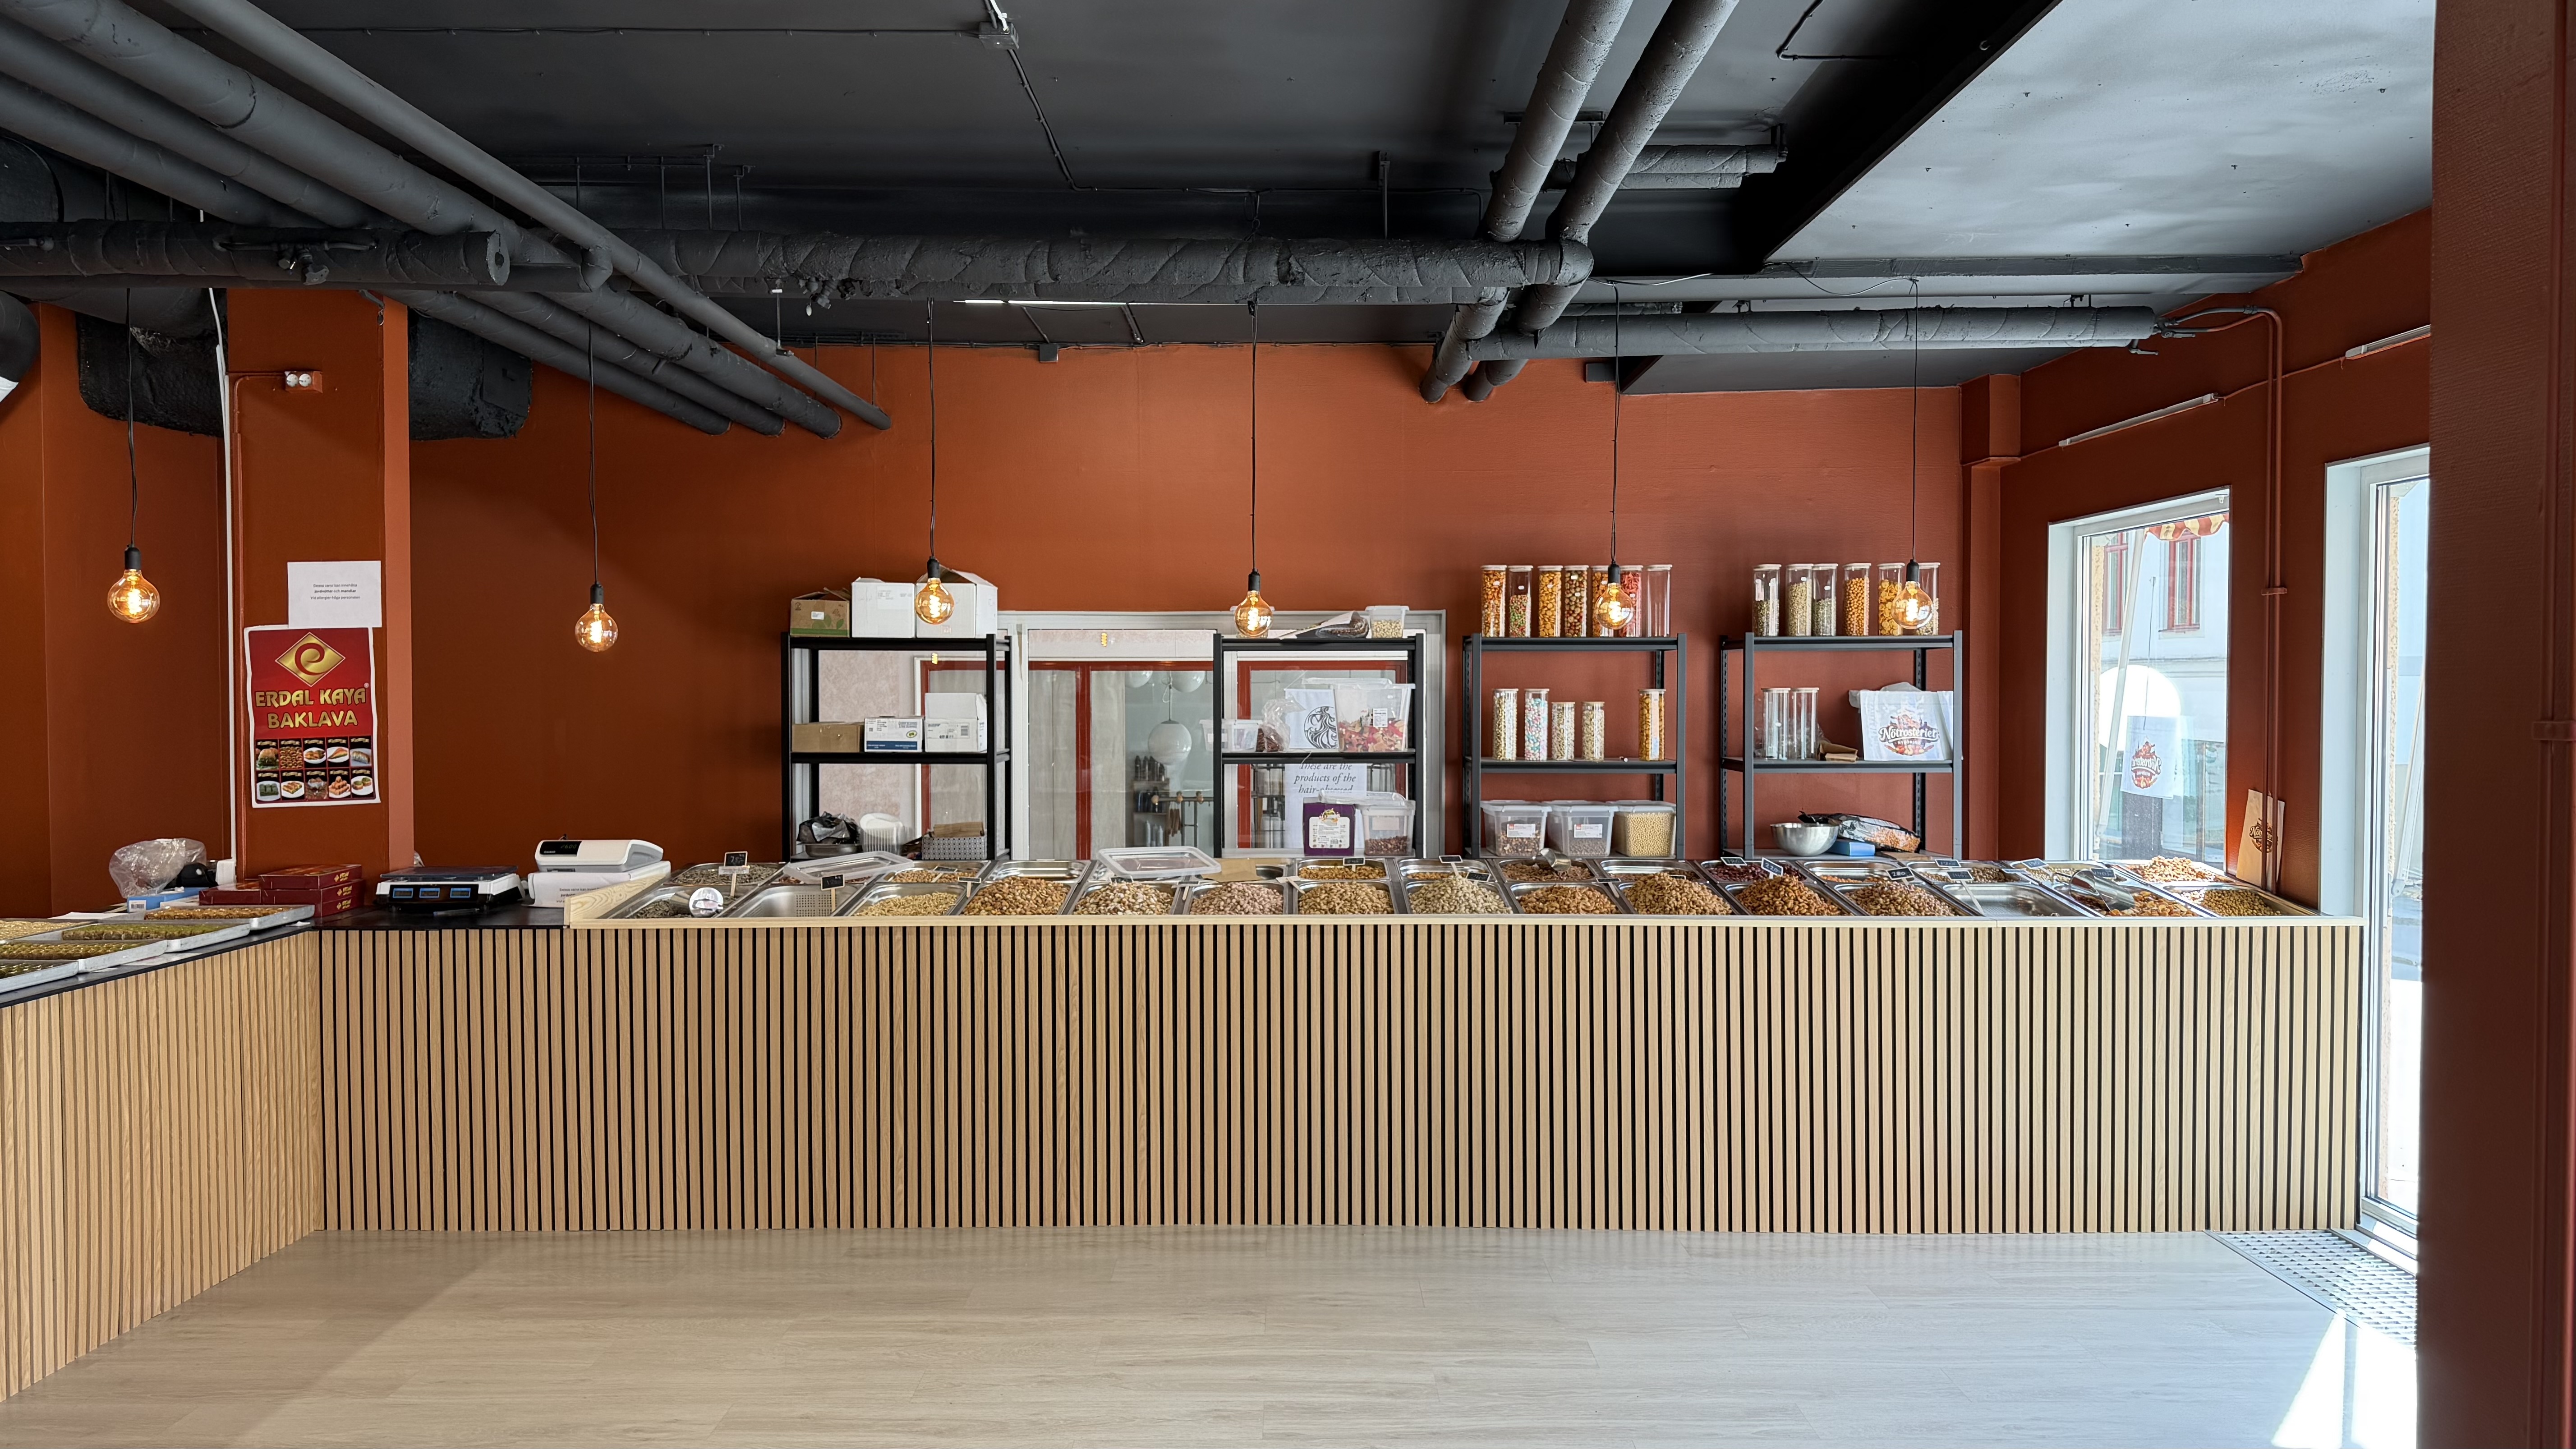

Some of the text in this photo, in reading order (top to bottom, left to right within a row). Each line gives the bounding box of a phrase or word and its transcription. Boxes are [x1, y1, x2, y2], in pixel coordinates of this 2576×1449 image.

[255, 688, 366, 708] ERDAL KAYA
[267, 710, 358, 729] BAKLAVA
[1294, 773, 1356, 785] products of the
